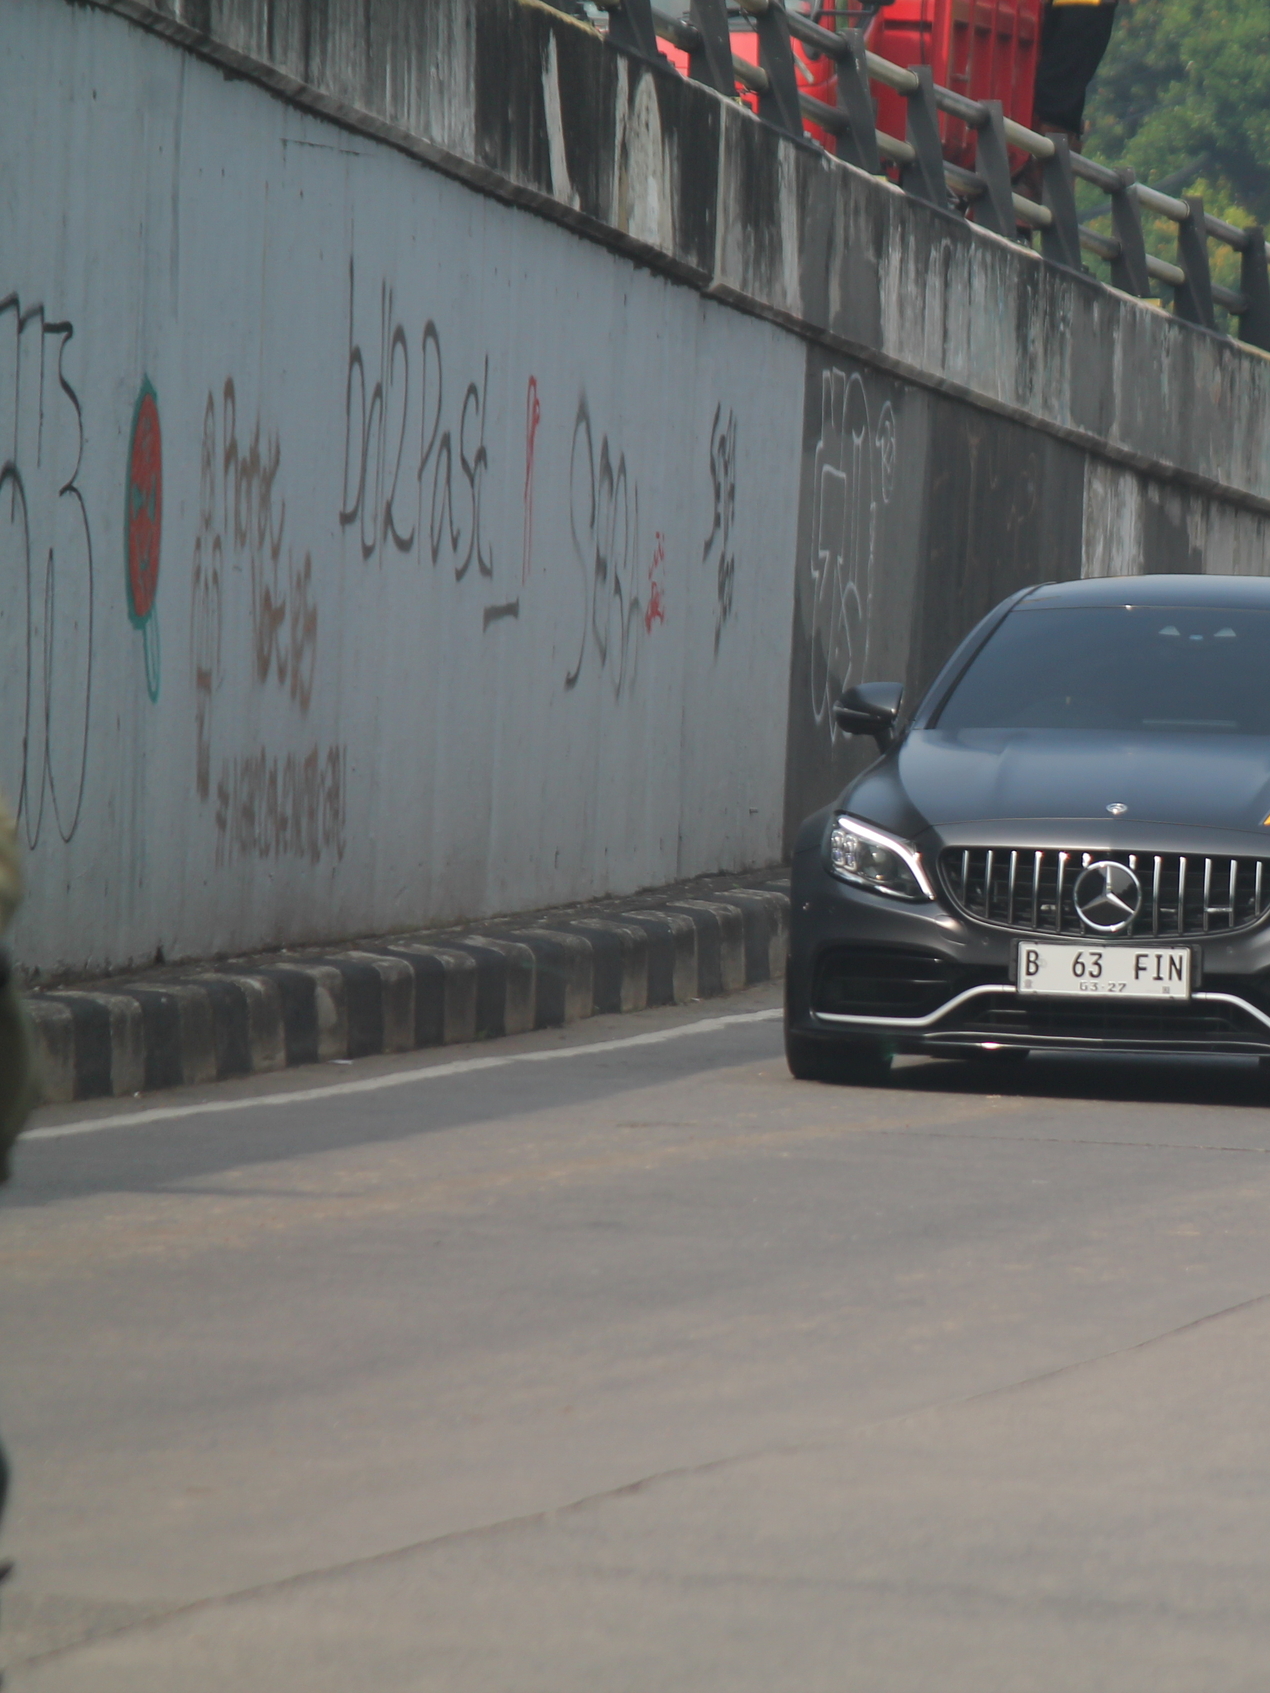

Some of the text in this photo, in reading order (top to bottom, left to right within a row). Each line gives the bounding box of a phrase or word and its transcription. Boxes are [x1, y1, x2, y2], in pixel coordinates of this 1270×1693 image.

[1026, 950, 1182, 981] B 63 FIN
